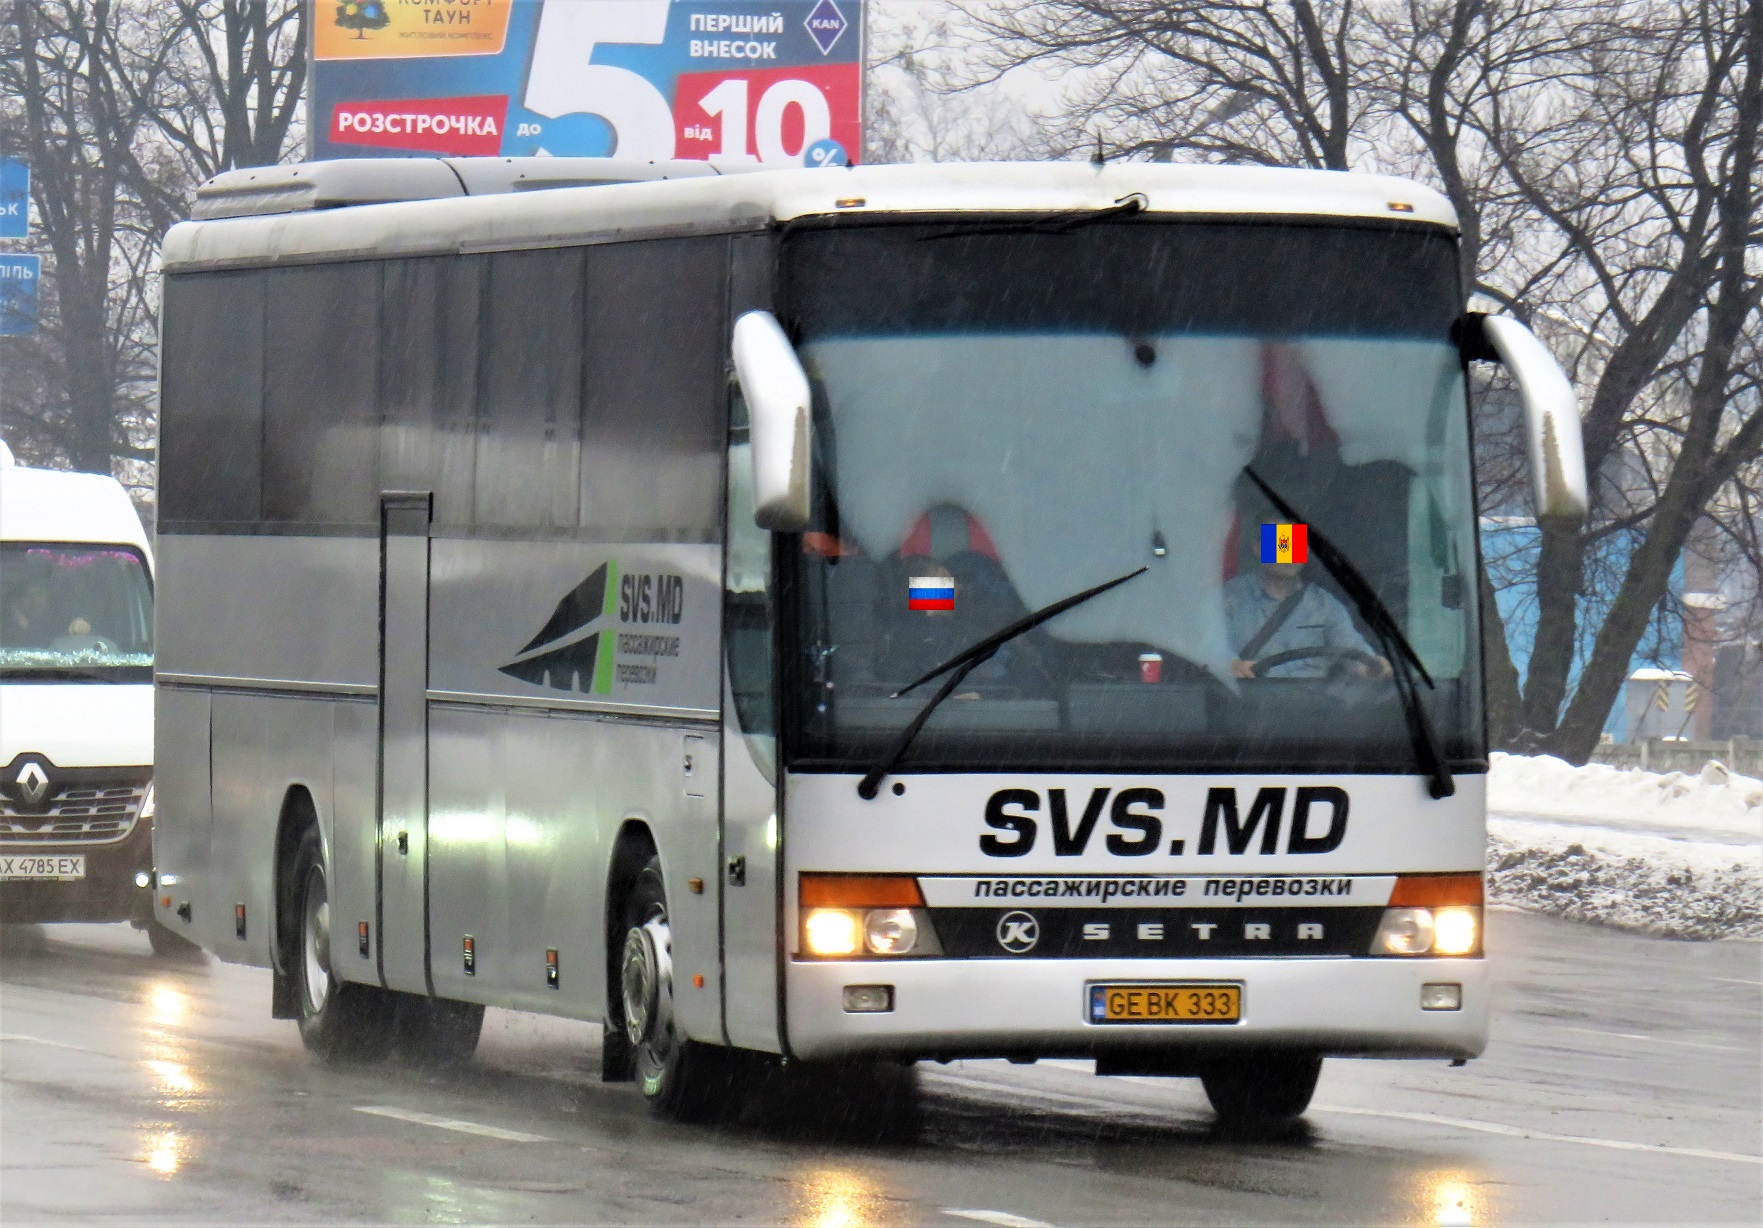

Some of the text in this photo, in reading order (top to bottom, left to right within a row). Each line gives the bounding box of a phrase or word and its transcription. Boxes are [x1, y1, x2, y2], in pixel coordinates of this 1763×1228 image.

[423, 9, 471, 24] ТАУН
[690, 12, 784, 33] ПЕРШИЙ
[812, 18, 839, 29] KAN
[689, 40, 777, 59] ВНЕСОК
[516, 0, 676, 158] до 5
[338, 112, 498, 136] РОЗСТРОЧКА
[684, 124, 713, 141] від
[698, 79, 831, 166] 10
[620, 574, 684, 624] SVS.MD
[979, 786, 1351, 858] SVS.MD
[19, 858, 54, 874] 4785
[58, 858, 80, 874] EX
[974, 878, 1353, 903] пассажирские перевозки
[1083, 923, 1325, 940] SETRA
[1188, 992, 1232, 1016] 333
